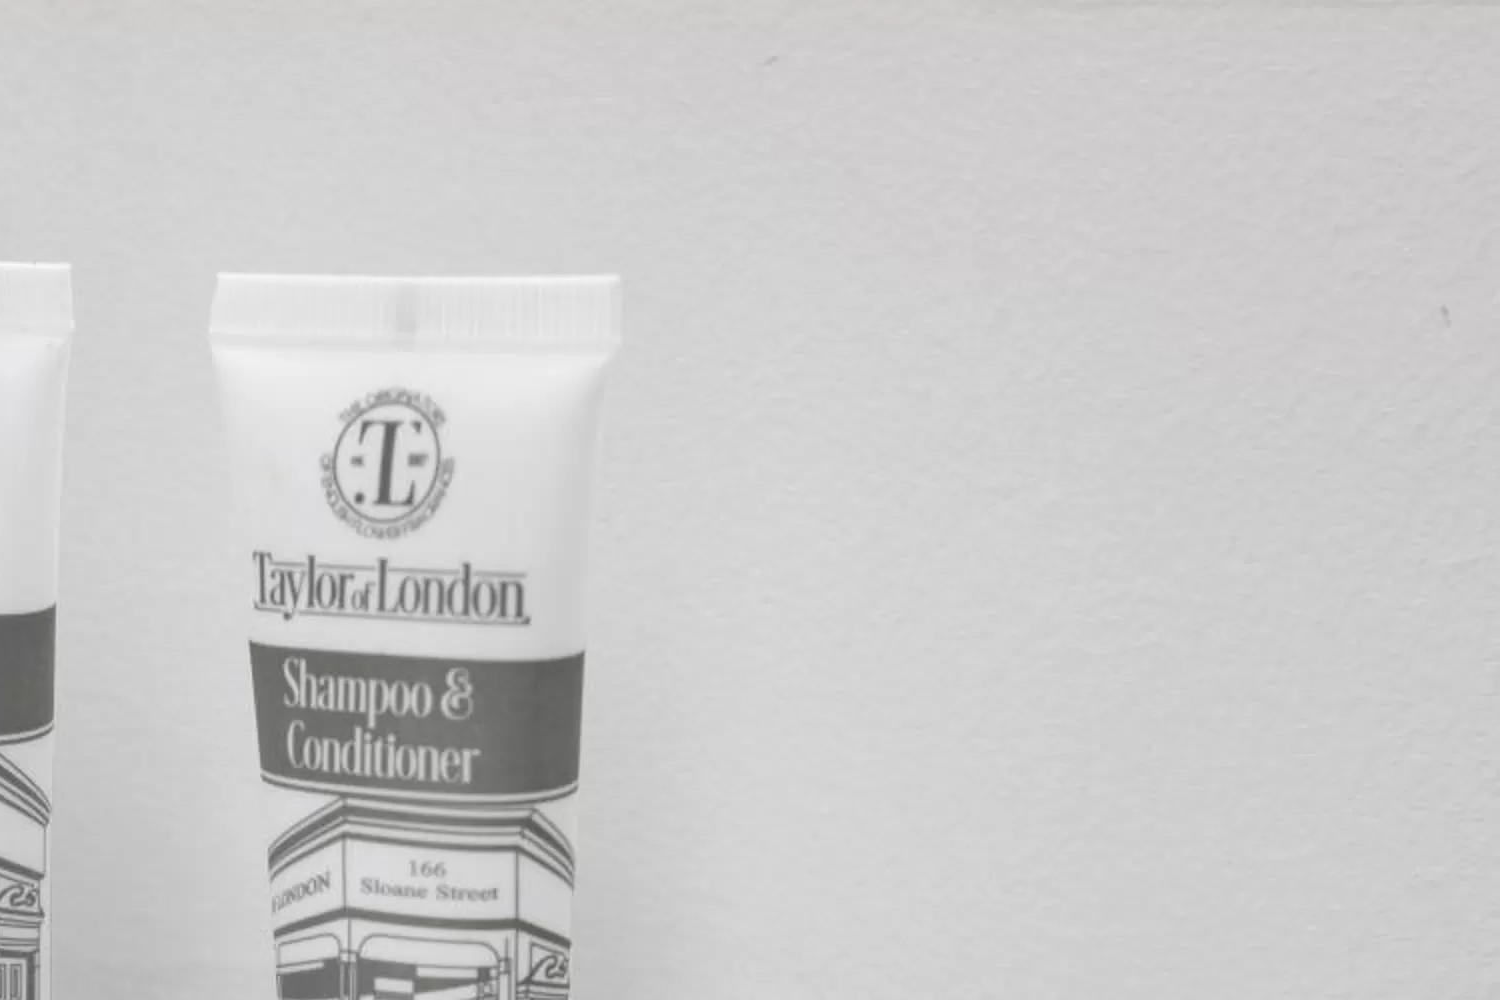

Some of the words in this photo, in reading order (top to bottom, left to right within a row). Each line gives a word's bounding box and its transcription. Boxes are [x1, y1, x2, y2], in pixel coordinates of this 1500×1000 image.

[252, 551, 354, 620] Taylor
[351, 581, 375, 611] of
[375, 557, 526, 619] London
[283, 656, 432, 729] Shampoo
[441, 667, 474, 720] &
[286, 720, 482, 785] Conditioner
[360, 877, 428, 900] Sloane
[435, 883, 499, 902] Street
[408, 860, 448, 878] 166
